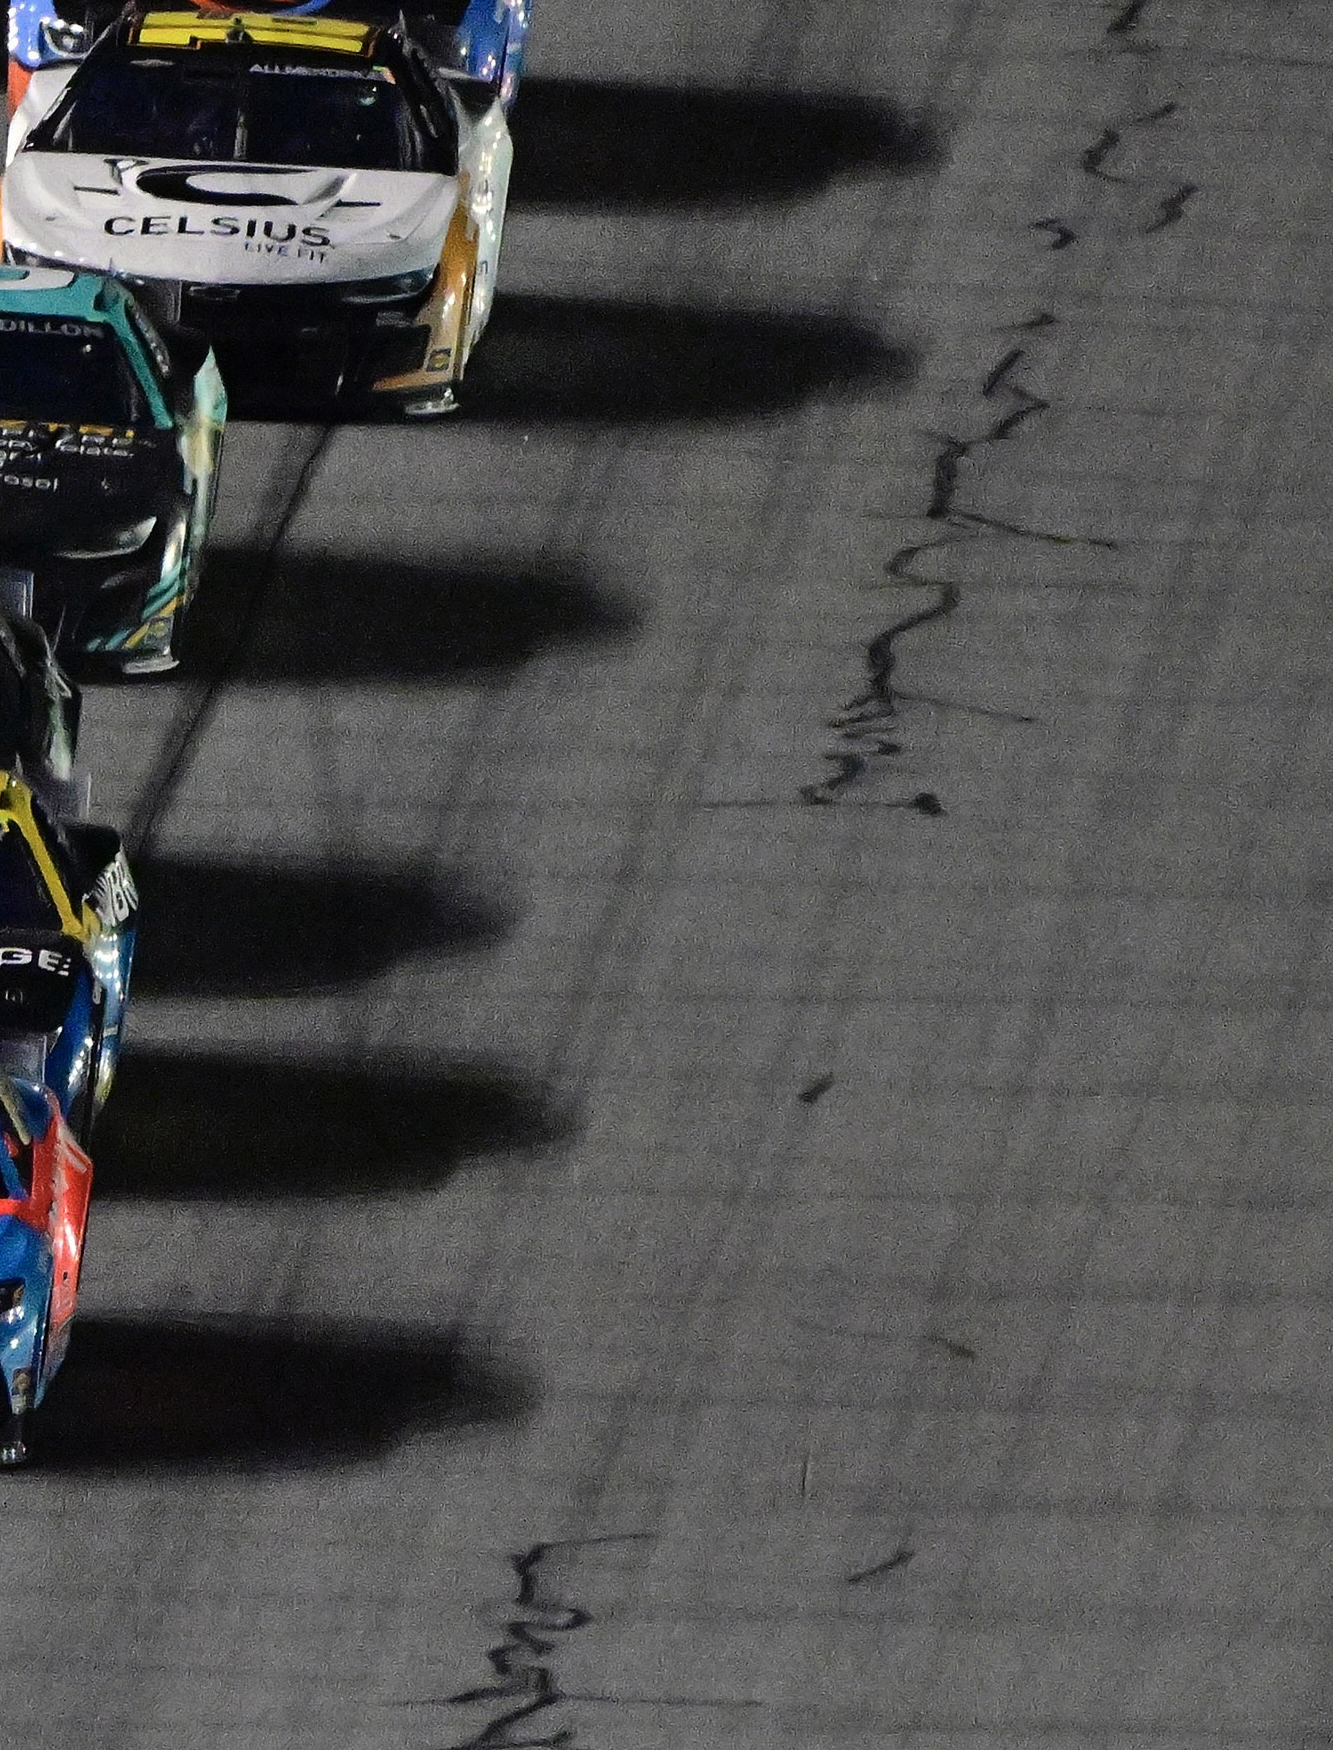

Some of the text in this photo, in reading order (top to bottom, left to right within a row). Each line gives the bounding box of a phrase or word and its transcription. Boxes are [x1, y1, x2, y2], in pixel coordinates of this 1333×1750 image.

[104, 215, 332, 248] CELSIUS
[244, 241, 328, 263] LIVE FIT
